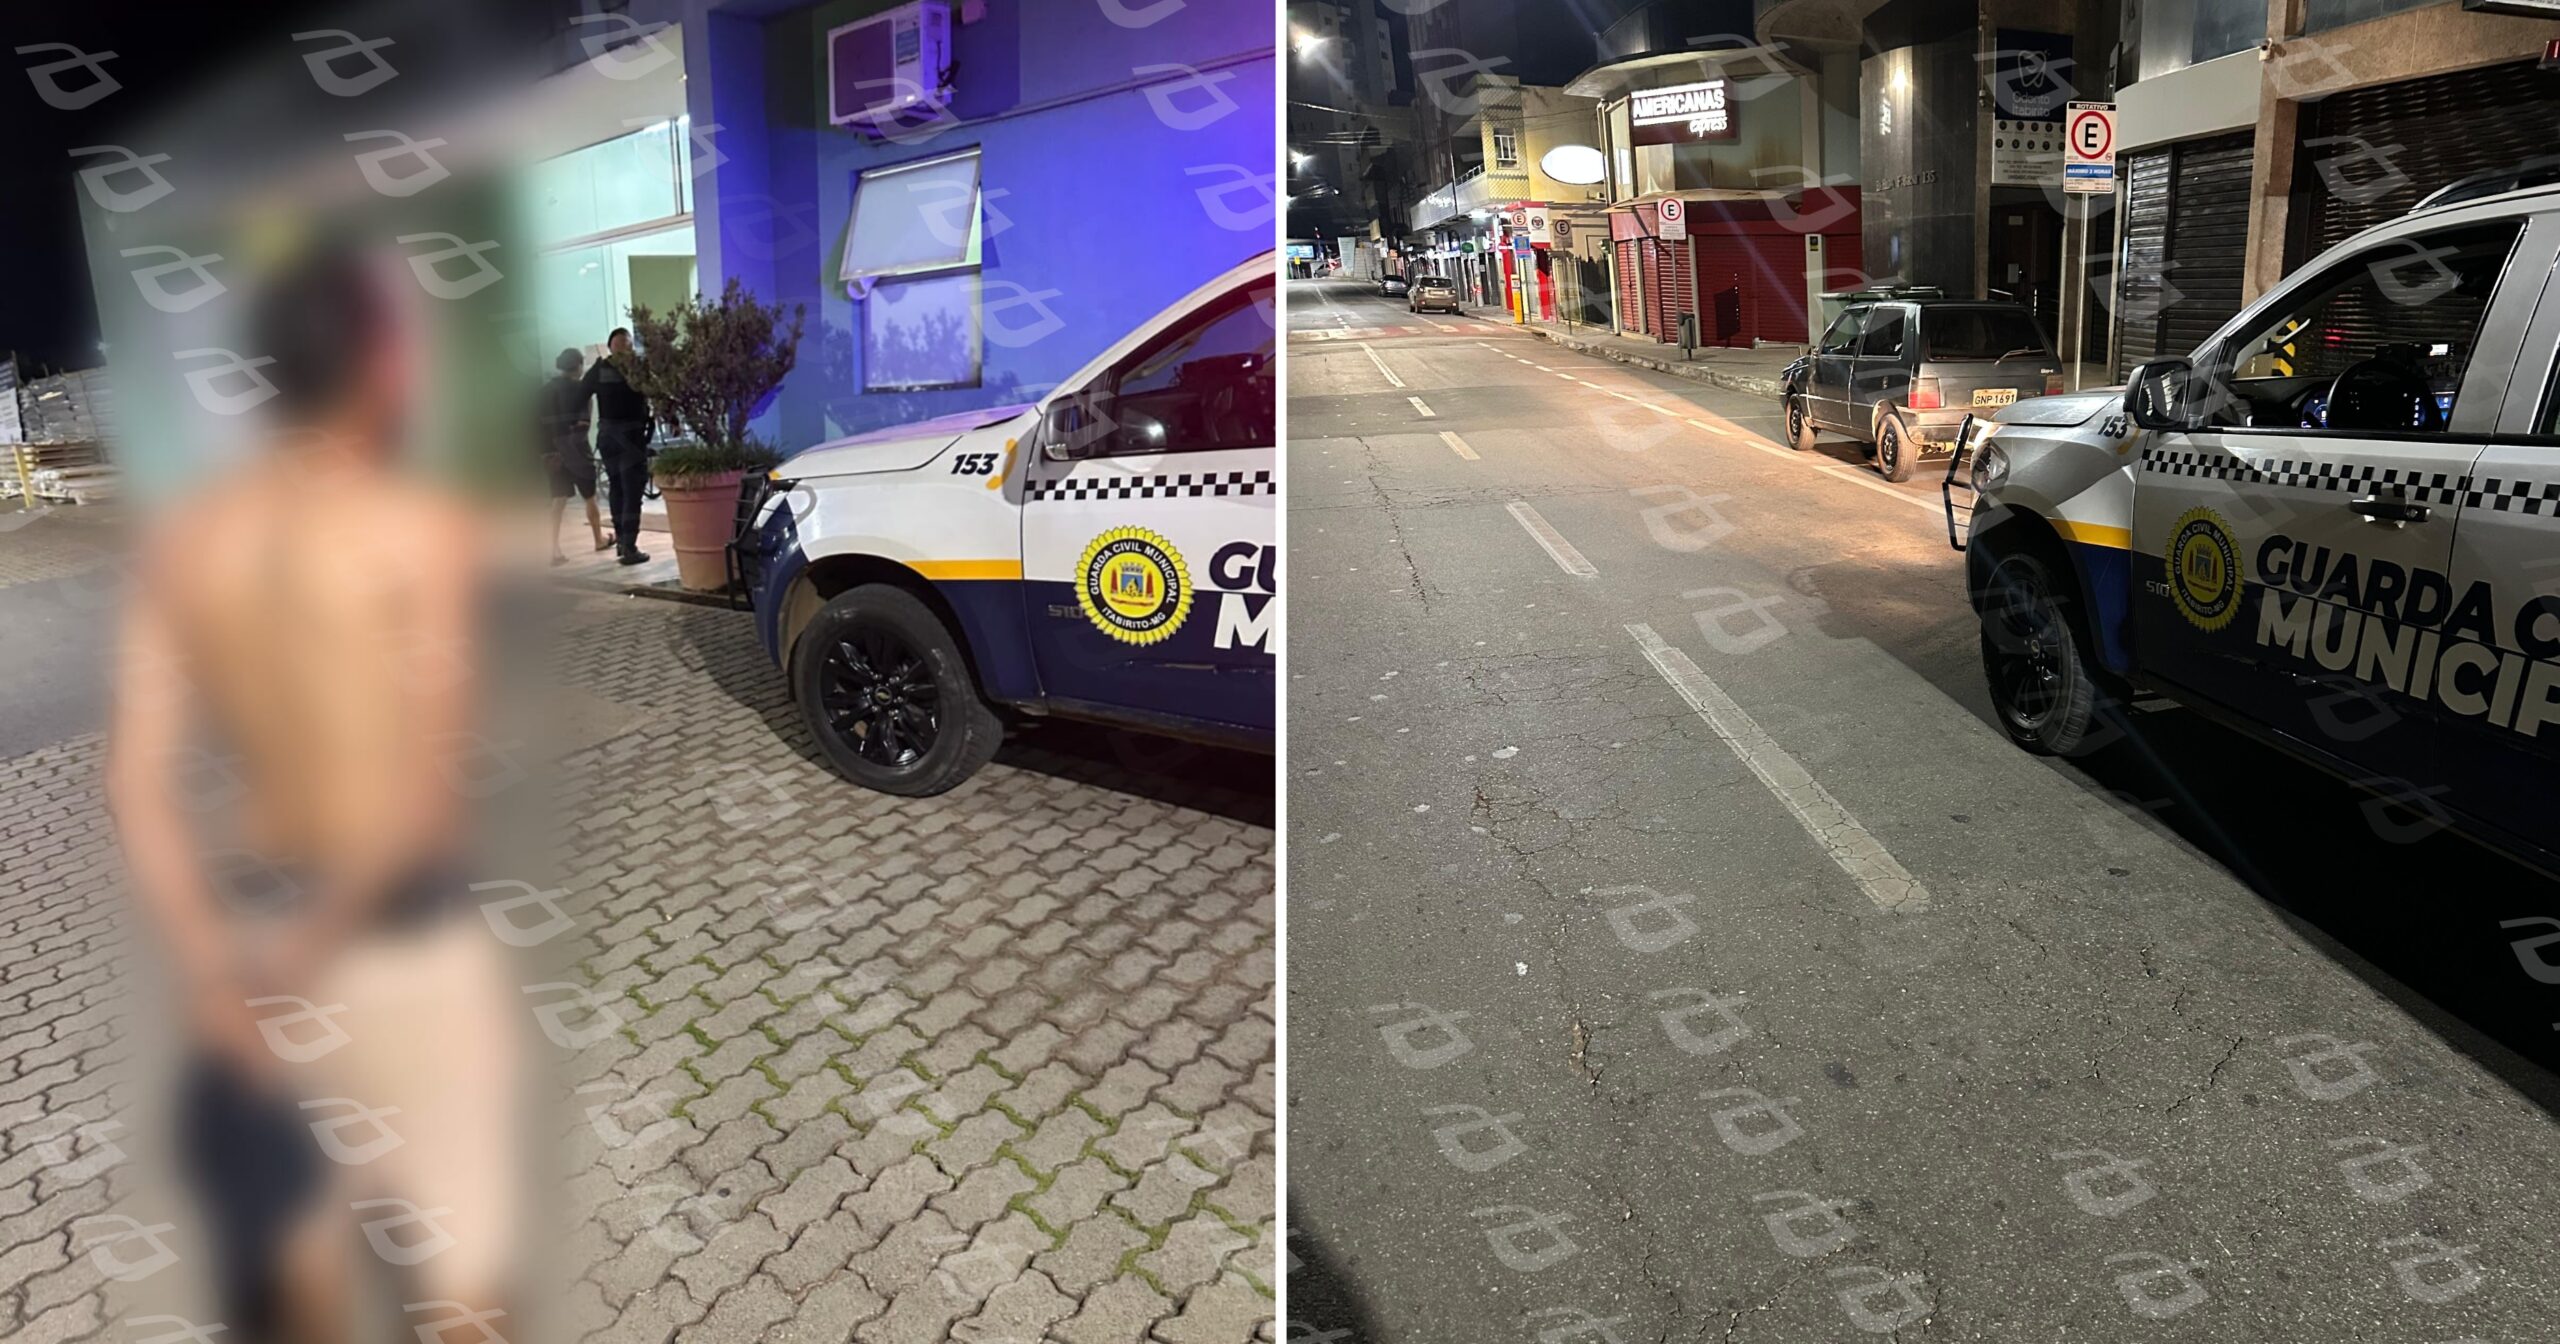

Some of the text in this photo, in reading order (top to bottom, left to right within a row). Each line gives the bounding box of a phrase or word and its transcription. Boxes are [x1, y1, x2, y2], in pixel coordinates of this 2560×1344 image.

[1633, 88, 1725, 119] AMERICANAS
[2076, 103, 2109, 111] ROTATIVO
[2084, 123, 2099, 148] E
[1668, 204, 1676, 216] E
[1559, 223, 1566, 232] E
[1974, 394, 2015, 405] GNP 1691
[2097, 415, 2128, 439] 153
[951, 453, 999, 475] 153
[2174, 523, 2235, 592] GUARDA CIVIL MUNICIPAL
[1090, 541, 1178, 604] GUARDA CIVIL MUNICIPAL
[2256, 534, 2560, 659] GUARDA C
[1101, 606, 1167, 629] ITABIRITO-MG
[2256, 587, 2560, 737] MUNICIP
